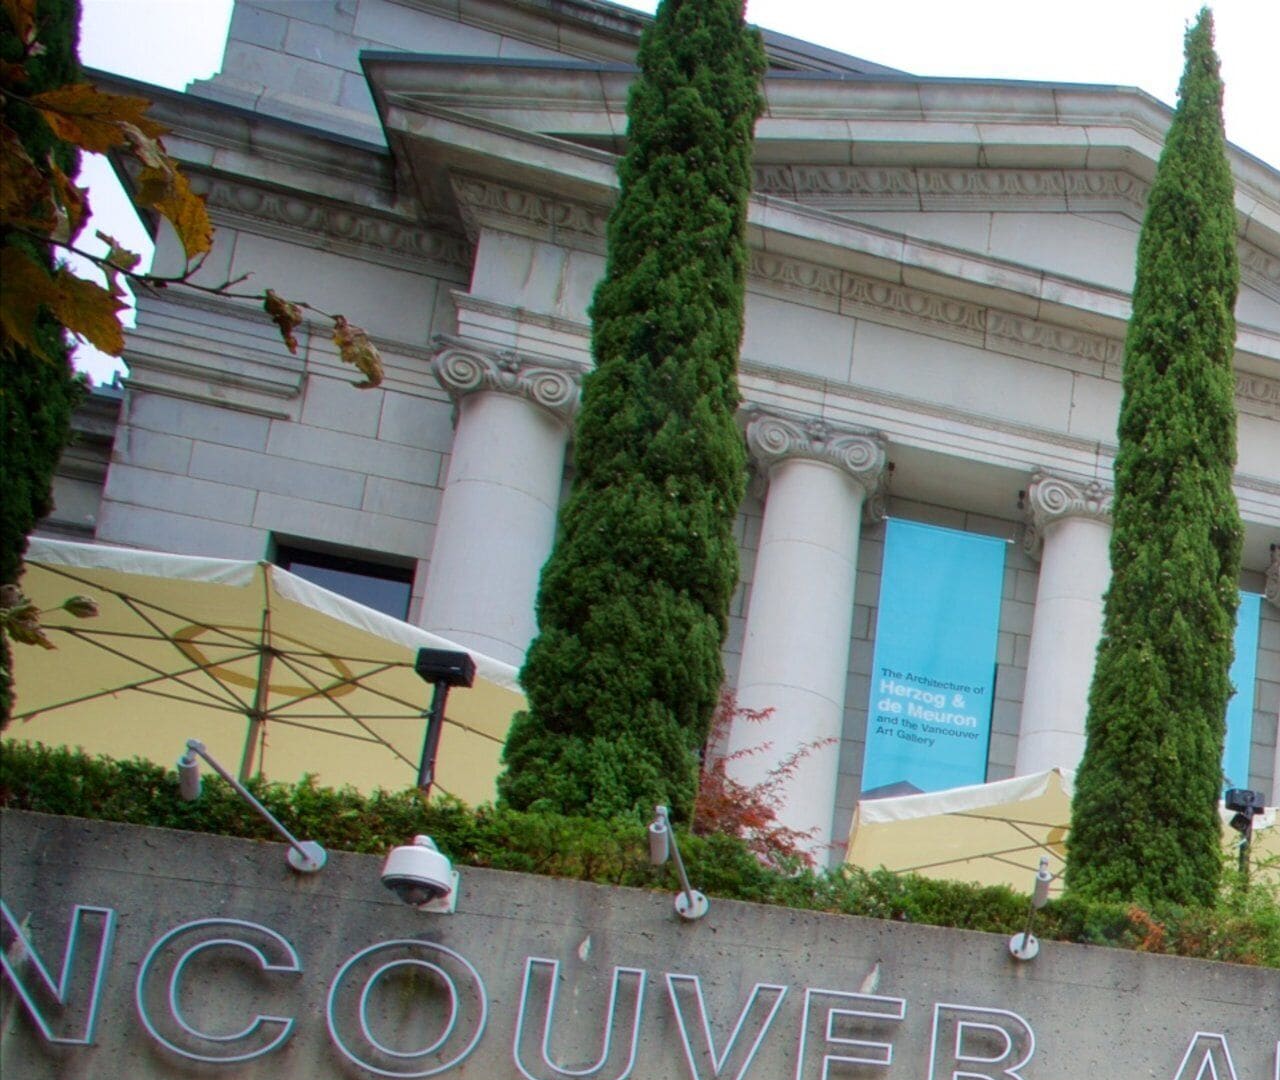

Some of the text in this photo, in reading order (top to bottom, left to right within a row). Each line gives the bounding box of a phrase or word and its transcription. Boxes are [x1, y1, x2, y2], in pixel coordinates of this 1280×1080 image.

[880, 679, 966, 708] Herzog &
[881, 668, 985, 695] The Architecture of
[878, 698, 977, 728] de Meuron
[876, 715, 980, 740] and the Vancouver
[876, 726, 935, 747] Art Gallery
